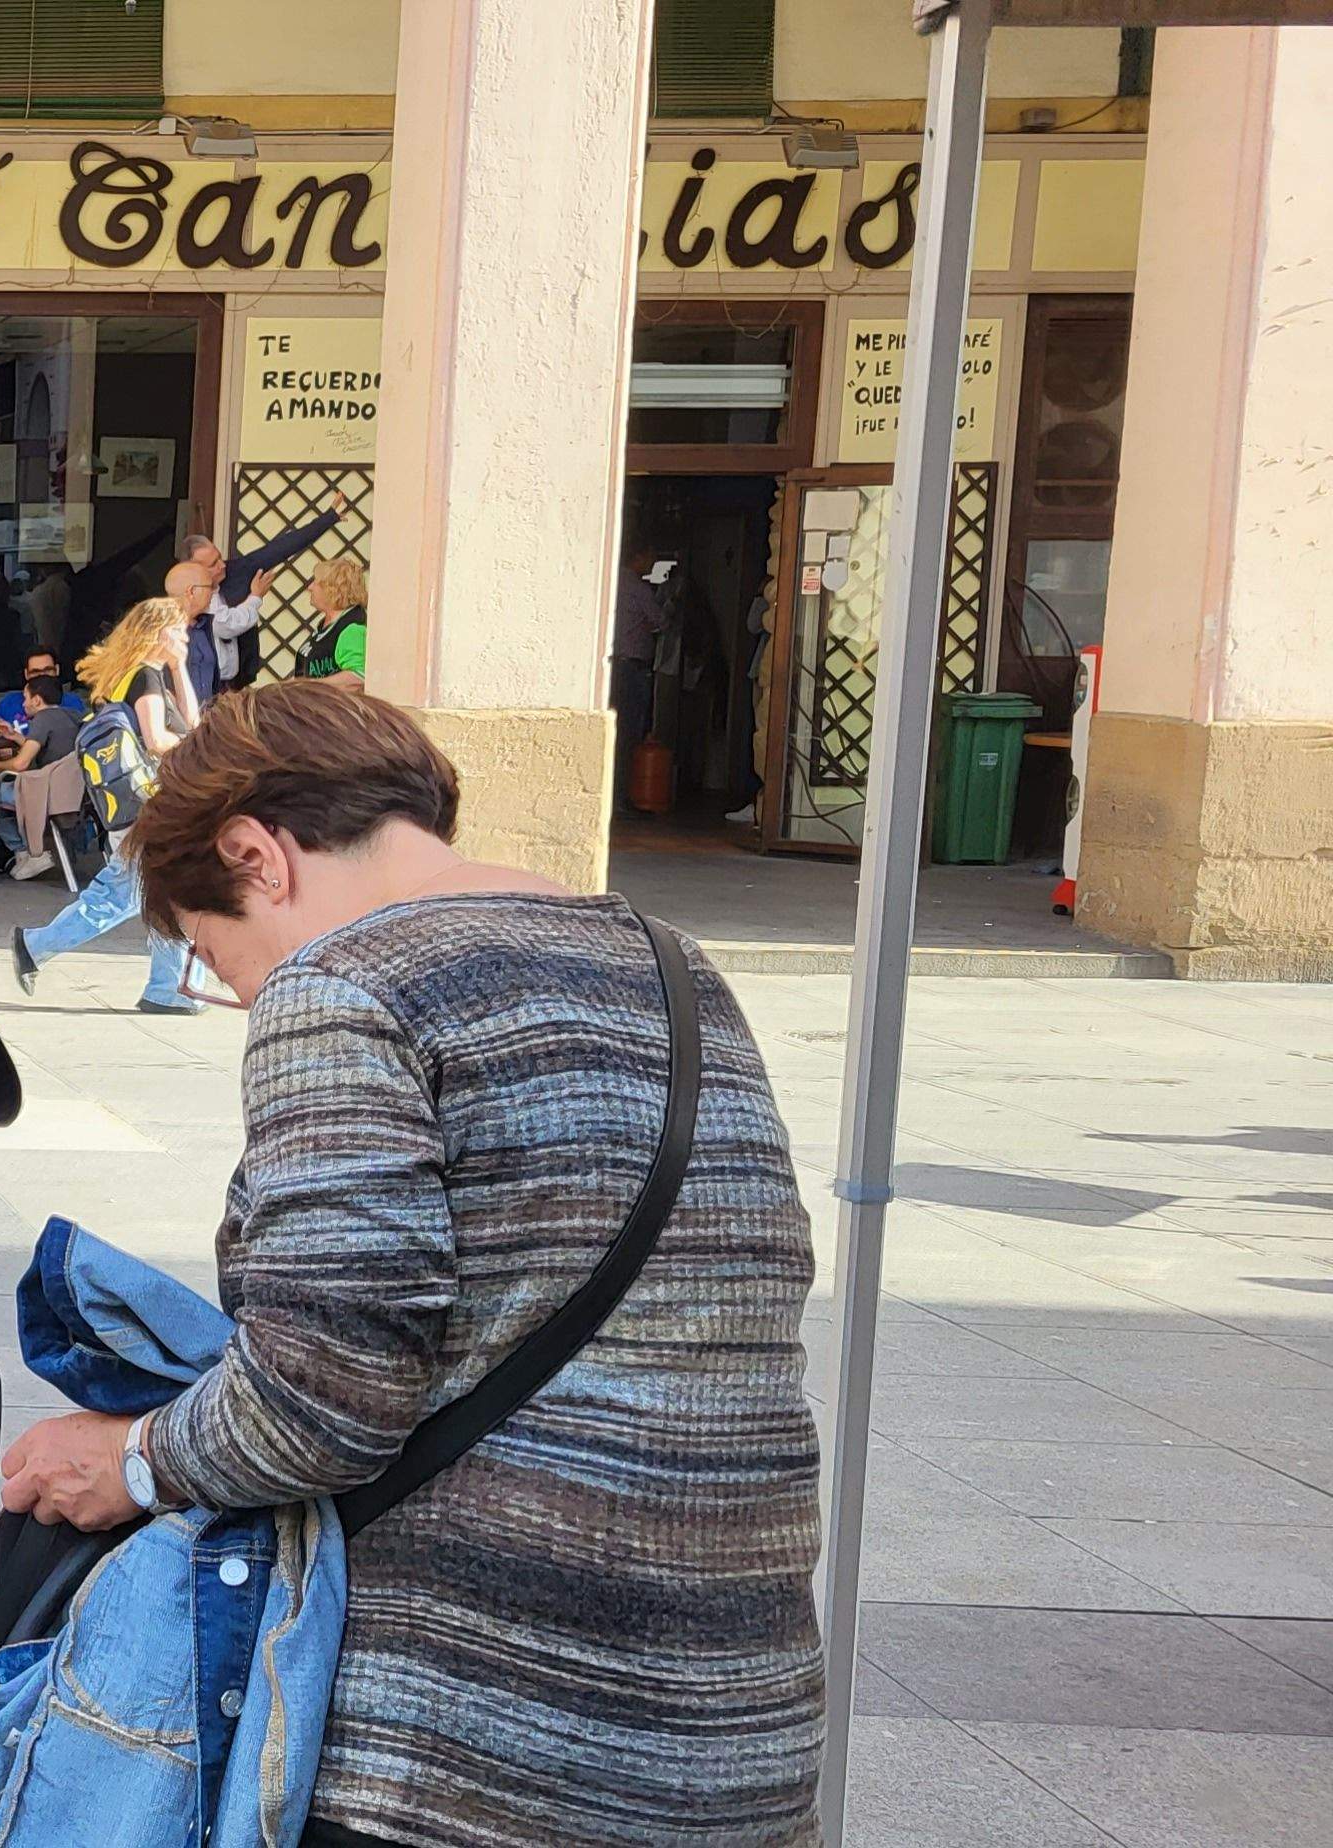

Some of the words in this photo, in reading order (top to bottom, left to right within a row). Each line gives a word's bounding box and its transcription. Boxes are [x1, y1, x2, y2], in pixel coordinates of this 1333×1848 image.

[258, 334, 291, 356] TE
[855, 333, 883, 351] ME
[963, 326, 993, 348] AFÉ
[855, 360, 867, 377] Y
[875, 360, 892, 377] LE
[962, 359, 992, 375] OLO
